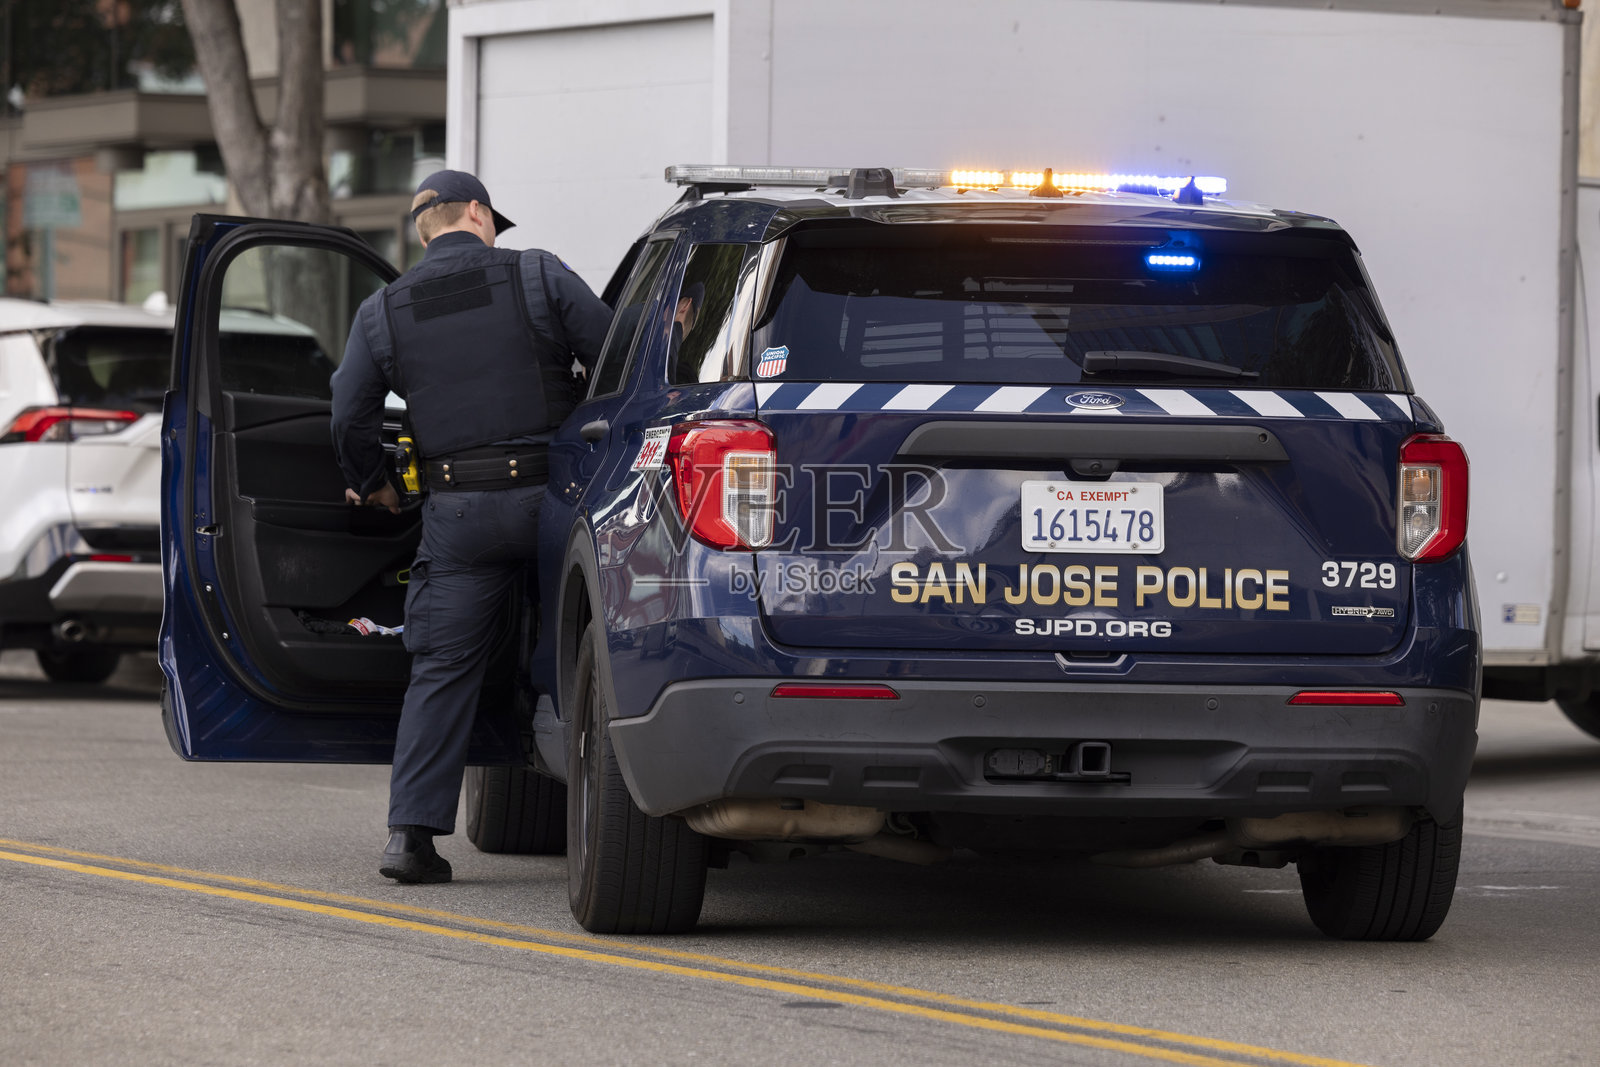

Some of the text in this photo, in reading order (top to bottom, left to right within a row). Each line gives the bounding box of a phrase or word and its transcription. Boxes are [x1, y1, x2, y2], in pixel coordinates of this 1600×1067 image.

[1080, 394, 1111, 405] Ford
[1056, 490, 1129, 502] CA EXEMPT
[1032, 508, 1154, 543] 1615478
[890, 562, 1290, 611] SAN JOSE POLICE
[1321, 560, 1397, 589] 3729
[1015, 618, 1172, 638] SJPD.ORG
